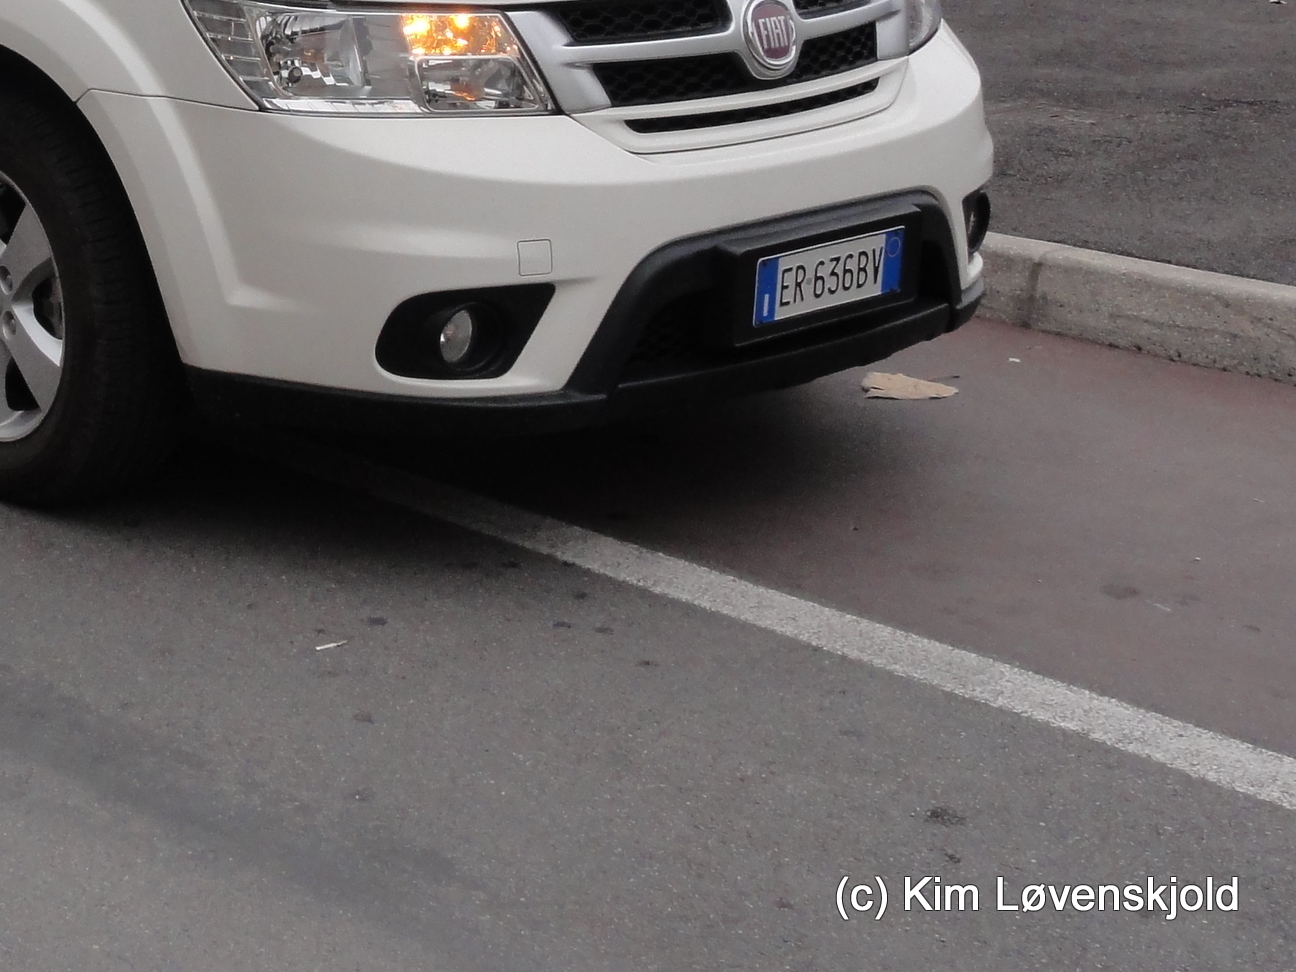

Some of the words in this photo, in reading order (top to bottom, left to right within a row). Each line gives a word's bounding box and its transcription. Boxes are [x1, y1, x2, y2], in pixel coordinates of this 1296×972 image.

[758, 15, 789, 49] FIAT
[779, 264, 807, 307] ER
[813, 245, 884, 299] 636BV
